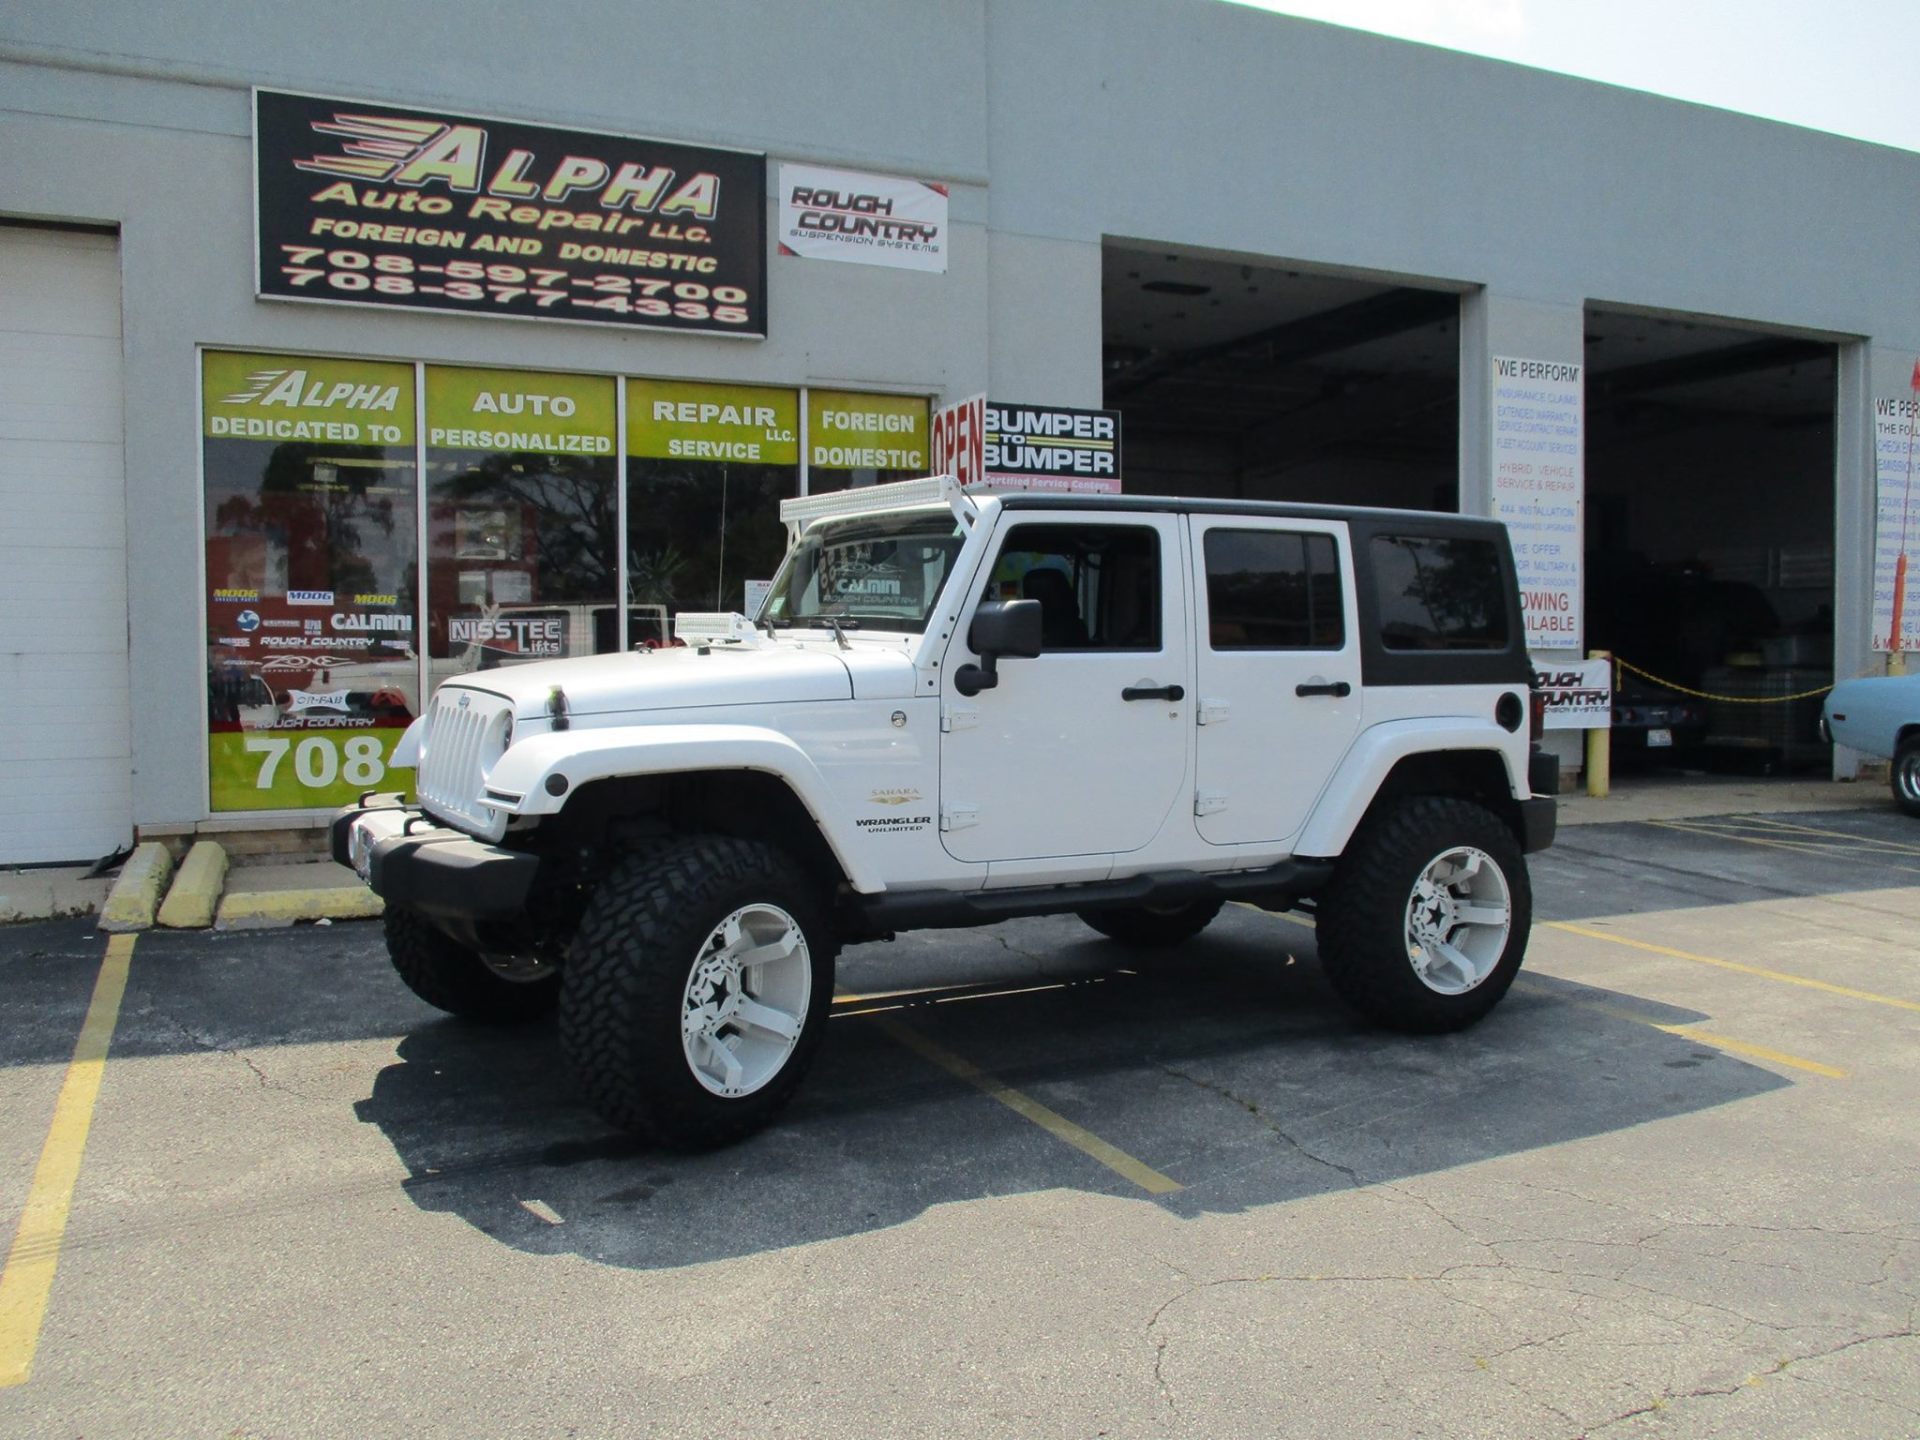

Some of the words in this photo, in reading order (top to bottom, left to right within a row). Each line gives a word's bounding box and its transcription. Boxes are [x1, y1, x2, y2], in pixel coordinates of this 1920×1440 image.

[394, 124, 720, 221] ALPHA
[311, 181, 453, 214] Auto
[468, 196, 643, 235] Repair
[791, 186, 893, 215] ROUGH
[797, 211, 938, 243] COUNTRY
[310, 218, 467, 248] FOREIGN
[471, 235, 543, 255] AND
[558, 243, 718, 273] DOMESTIC
[789, 229, 874, 246] SUSPENSION
[877, 239, 940, 253] SYSTEMS
[281, 245, 748, 304] 708-597-2700
[281, 267, 749, 323] 708-377-4335
[260, 370, 400, 411] ALPHA
[473, 392, 576, 417] AUTO
[653, 401, 777, 427] REPAIR
[1877, 399, 1896, 416] WE
[211, 416, 360, 441] DEDICATED
[367, 424, 402, 443] TO
[822, 410, 915, 433] FOREIGN
[985, 409, 1114, 439] BUMPER
[1878, 423, 1897, 435] THE
[431, 428, 611, 453] PERSONALIZED
[932, 398, 984, 487] OPEN
[1000, 434, 1026, 444] TO
[669, 439, 761, 460] SERVICE
[814, 447, 921, 468] DOMESTIC
[985, 445, 1114, 473] BUMPER
[1499, 463, 1533, 474] HYBRID
[1539, 464, 1574, 477] VEHICLE
[1032, 478, 1070, 488] Service
[1497, 477, 1535, 490] SERVICE
[1545, 480, 1576, 492] REPAIR
[1532, 544, 1561, 555] OFFER
[213, 589, 258, 598] MOOG
[289, 591, 332, 600] MOOG
[837, 579, 901, 594] CALMINI
[354, 593, 398, 605] MOOG
[1519, 592, 1569, 611] OWING
[330, 613, 412, 631] CALMINI
[451, 621, 560, 640] NISSTEC
[1525, 615, 1575, 632] ILABLE
[260, 637, 307, 646] ROUGH
[311, 637, 375, 646] COUNTRY
[1883, 637, 1912, 650] MCH
[1536, 672, 1584, 687] OUGH
[1542, 691, 1609, 706] OUNTRY
[254, 718, 305, 729] ROUGH
[307, 717, 375, 727] COUNTRY
[246, 736, 385, 789] 708
[872, 788, 920, 796] SAHARA
[856, 816, 931, 827] WRANGLER
